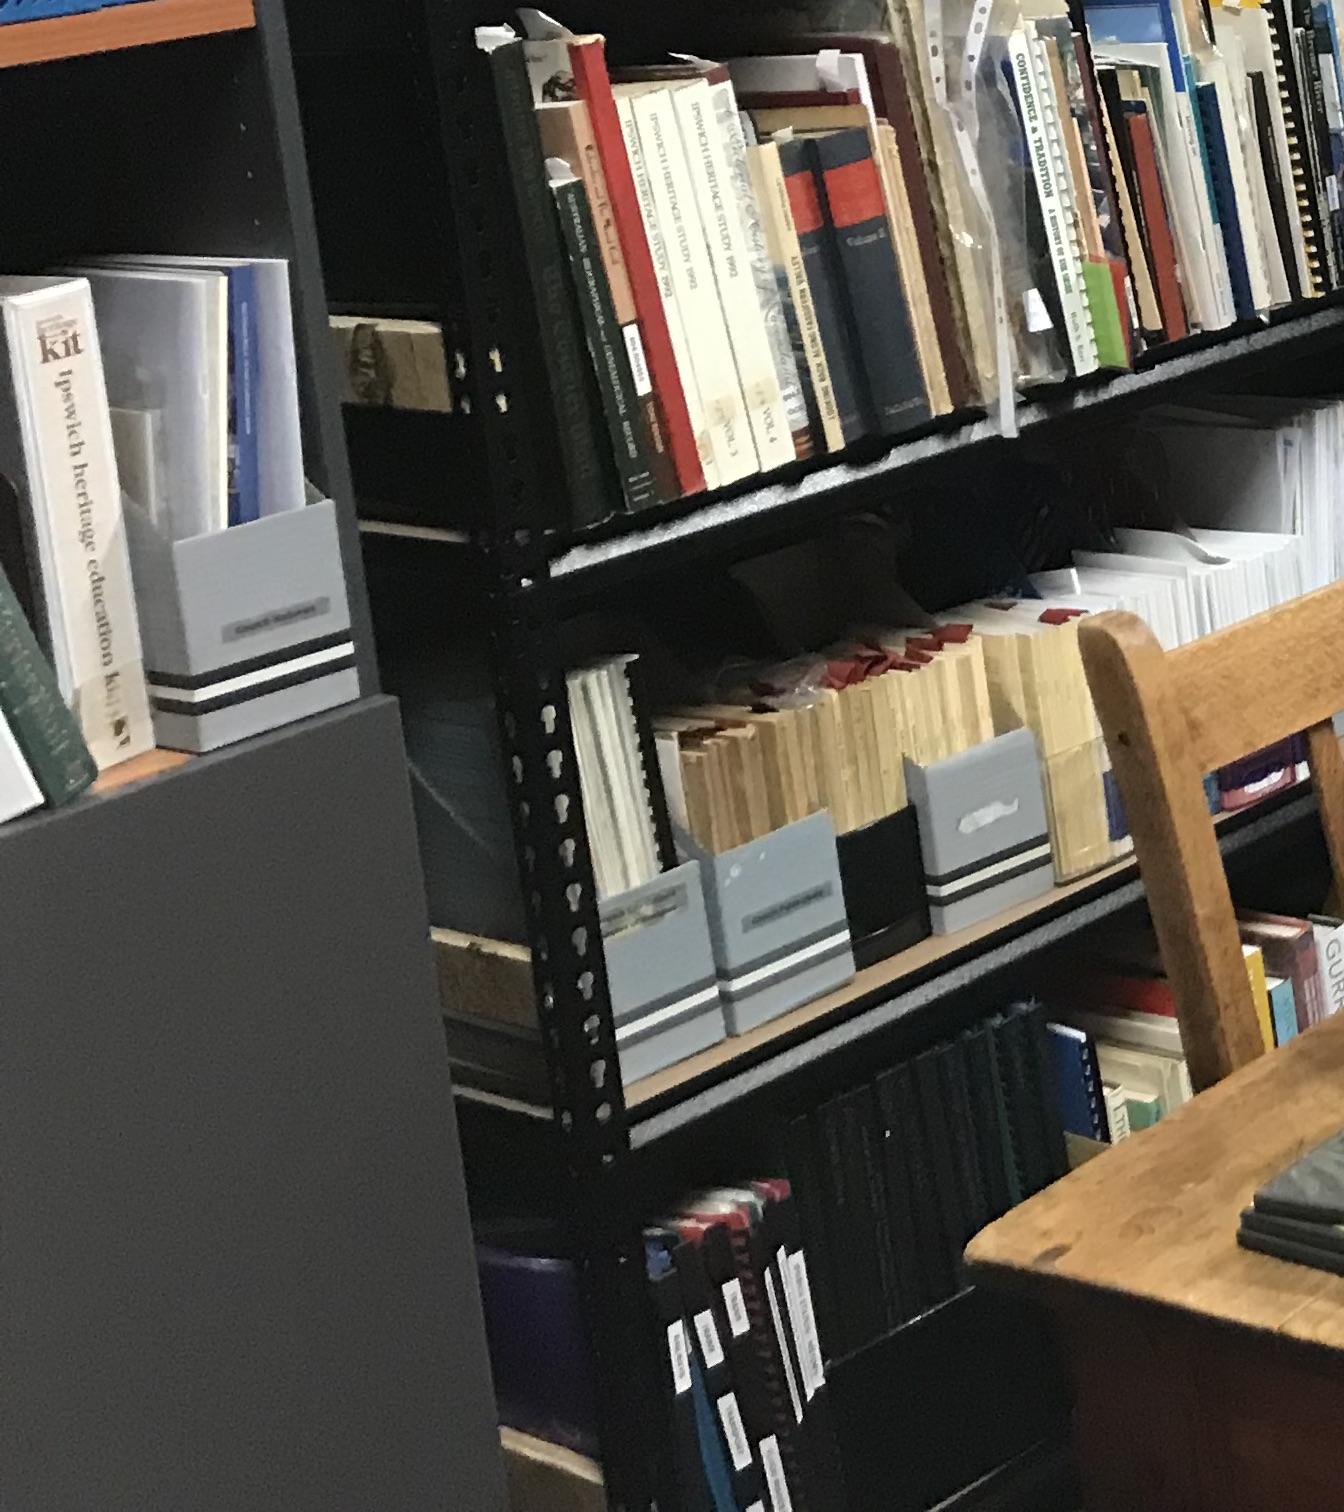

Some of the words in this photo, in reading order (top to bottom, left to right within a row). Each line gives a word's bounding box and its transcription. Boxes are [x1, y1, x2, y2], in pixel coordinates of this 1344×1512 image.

[691, 102, 710, 152] IPSWICH
[1016, 53, 1038, 123] CONFIDENCE
[1033, 137, 1054, 198] TRADITION
[1049, 216, 1062, 245] HISTORY
[623, 120, 640, 162] IPSWICH
[633, 166, 656, 229] HERITAGE
[651, 233, 666, 264] STUDY
[659, 268, 673, 299] 1992
[649, 113, 667, 162] IPSWICH
[661, 166, 683, 223] HERITAGE
[675, 226, 692, 264] STUDY
[685, 267, 698, 291] 1992
[703, 155, 724, 212] HERITAGE
[717, 213, 734, 251] STUDY
[725, 255, 738, 279] 1992
[37, 329, 84, 365] kit
[54, 370, 85, 458] Ipswich
[65, 462, 99, 554] heritage
[83, 558, 116, 668] education
